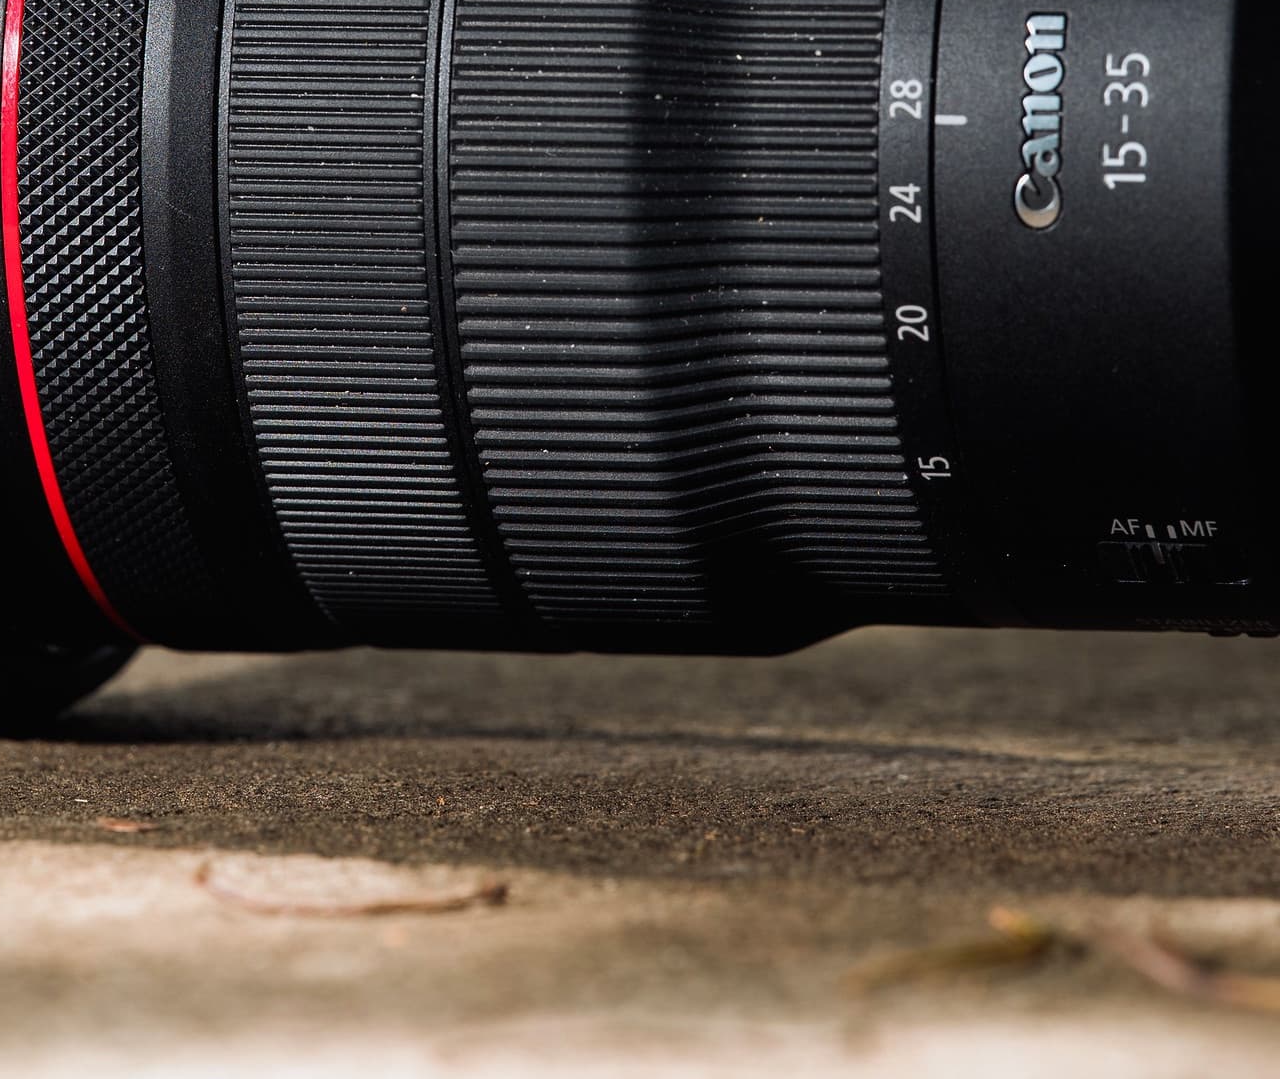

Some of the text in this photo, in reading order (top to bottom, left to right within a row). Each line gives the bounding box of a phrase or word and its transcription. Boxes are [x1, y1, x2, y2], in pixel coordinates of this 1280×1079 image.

[890, 79, 923, 120] 28
[1014, 11, 1068, 230] Canon
[890, 183, 923, 225] 24
[896, 304, 930, 343] 20
[920, 456, 952, 481] 15
[1110, 518, 1140, 535] AF
[1180, 519, 1218, 537] MF
